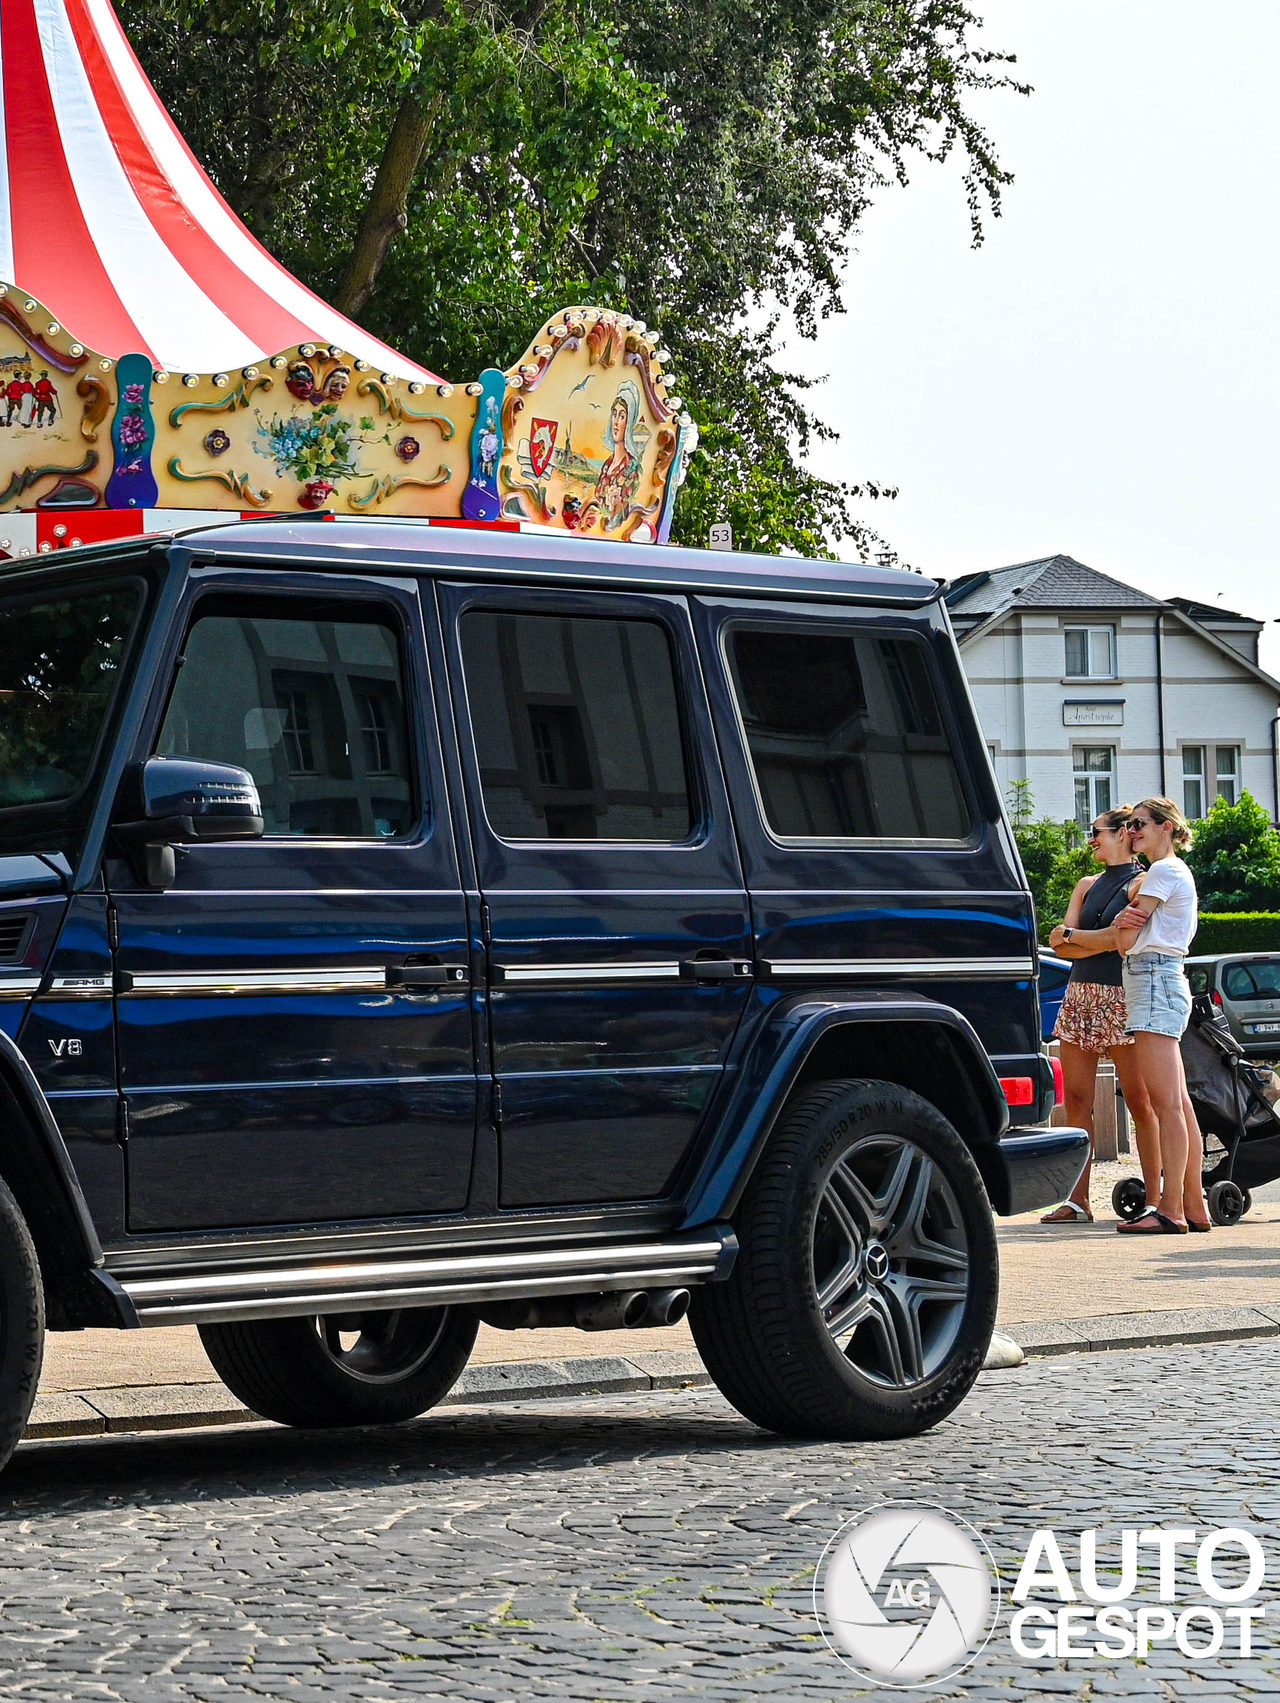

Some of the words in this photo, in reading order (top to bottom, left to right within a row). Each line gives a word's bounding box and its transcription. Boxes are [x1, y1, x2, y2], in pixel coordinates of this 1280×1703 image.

[712, 530, 730, 543] 53
[47, 1038, 83, 1056] V8
[814, 1119, 848, 1168] 285/50
[847, 1112, 858, 1126] R
[857, 1104, 873, 1121] 20
[875, 1100, 886, 1114] W
[890, 1099, 906, 1114] XL
[25, 1305, 38, 1333] 20
[24, 1342, 38, 1362] W
[16, 1370, 33, 1395] XL
